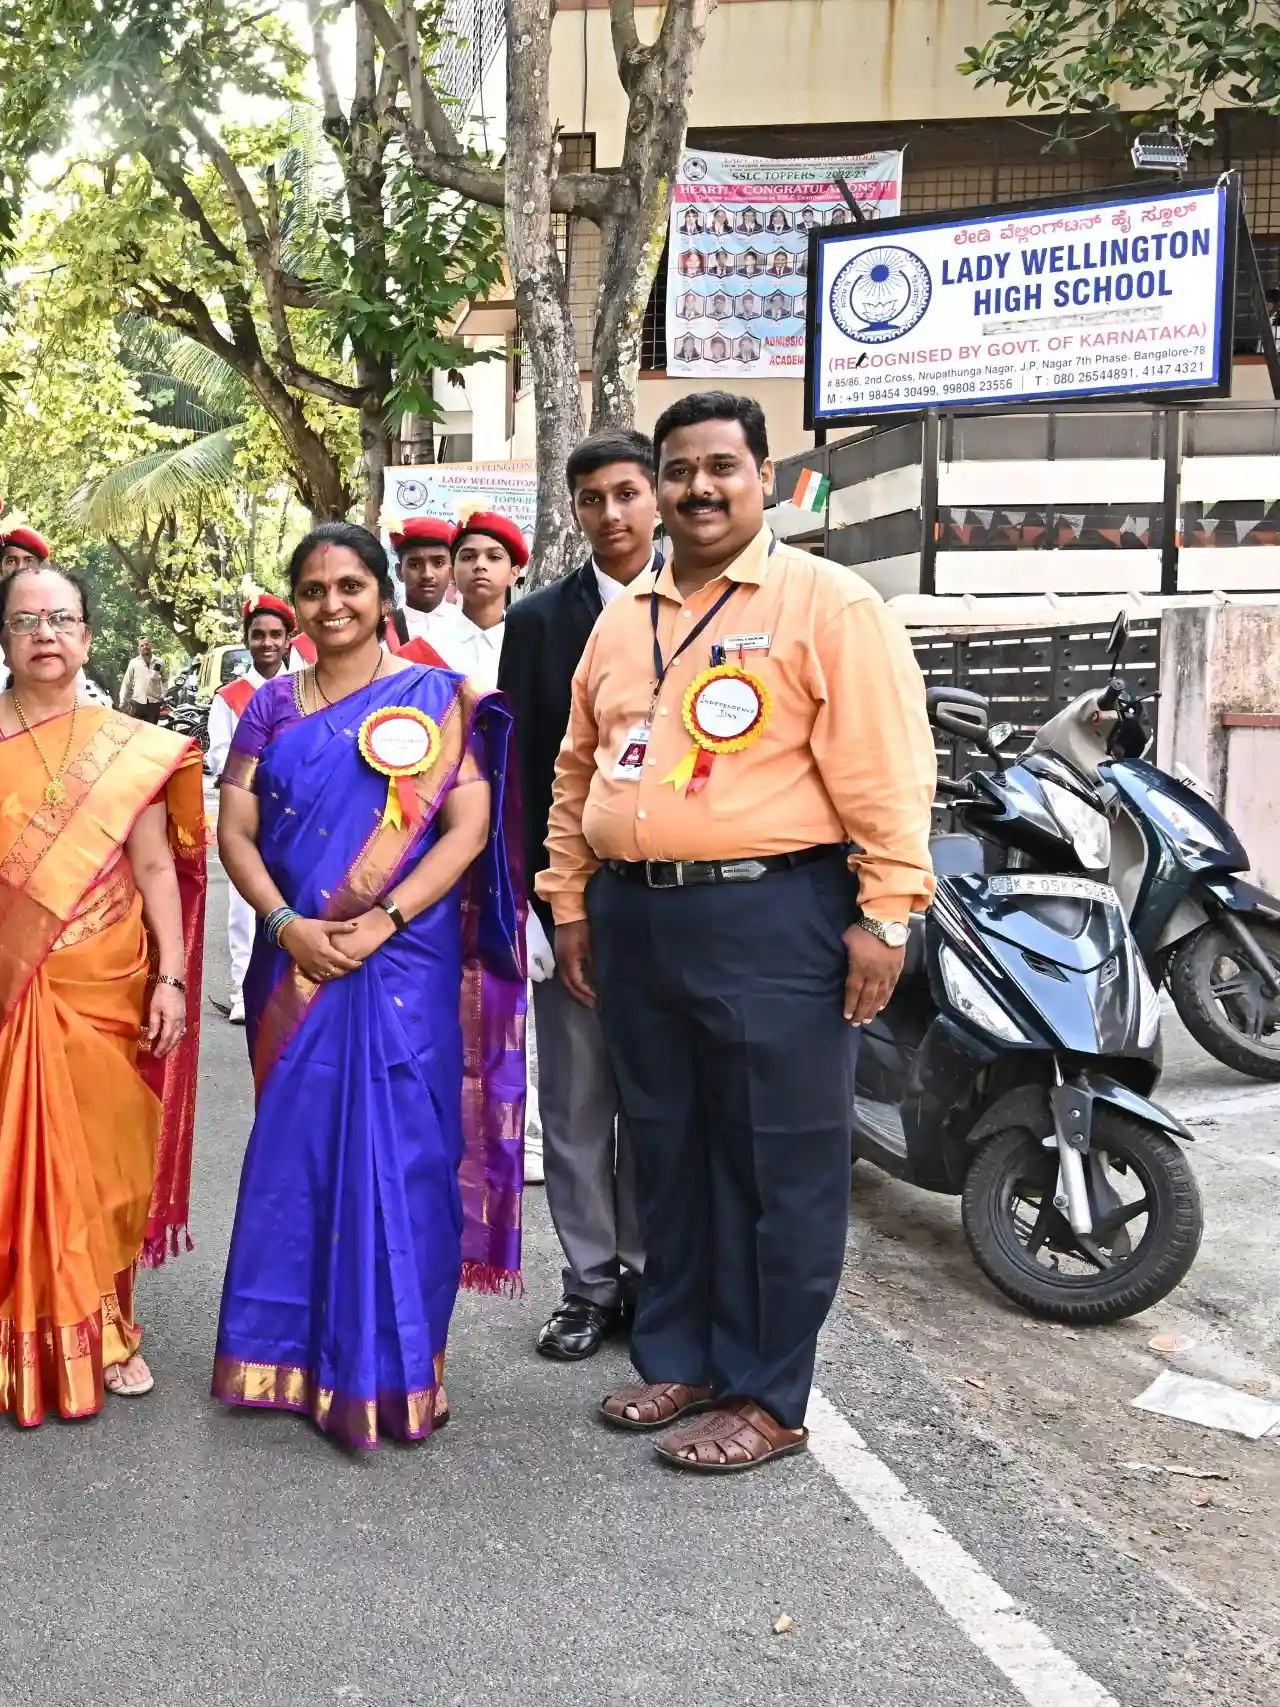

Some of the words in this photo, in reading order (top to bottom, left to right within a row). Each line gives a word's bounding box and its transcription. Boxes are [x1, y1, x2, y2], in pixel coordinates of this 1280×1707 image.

[680, 185, 740, 194] HEARTLY
[742, 183, 876, 194] CONGRATULAONS
[732, 171, 760, 180] SSLC
[765, 171, 816, 180] TOPPERS
[942, 252, 1011, 285] LADY
[1021, 227, 1211, 276] WELLINGTON
[973, 283, 1042, 316] HIGH
[1053, 269, 1173, 308] SCHOOL
[828, 348, 953, 373] (RECOGNISED
[958, 344, 982, 360] BY
[987, 339, 1040, 357] GOVT.
[1047, 335, 1074, 351] OF
[1079, 321, 1208, 348] KARNATAKA)
[864, 375, 882, 386] 2nd
[918, 366, 983, 382] Nrupathunga
[1041, 357, 1073, 371] Nagar
[1075, 355, 1092, 366] 7th
[1133, 345, 1207, 362] Bangalore-78
[1034, 375, 1043, 387] T
[1053, 373, 1075, 385] 080
[1142, 364, 1171, 377] 4147
[1174, 361, 1205, 374] 4321
[826, 393, 836, 405] M
[846, 391, 865, 403] +91
[868, 387, 901, 401] 98454
[942, 381, 976, 394] 99808
[979, 378, 1013, 391] 23556
[442, 476, 468, 484] LADY
